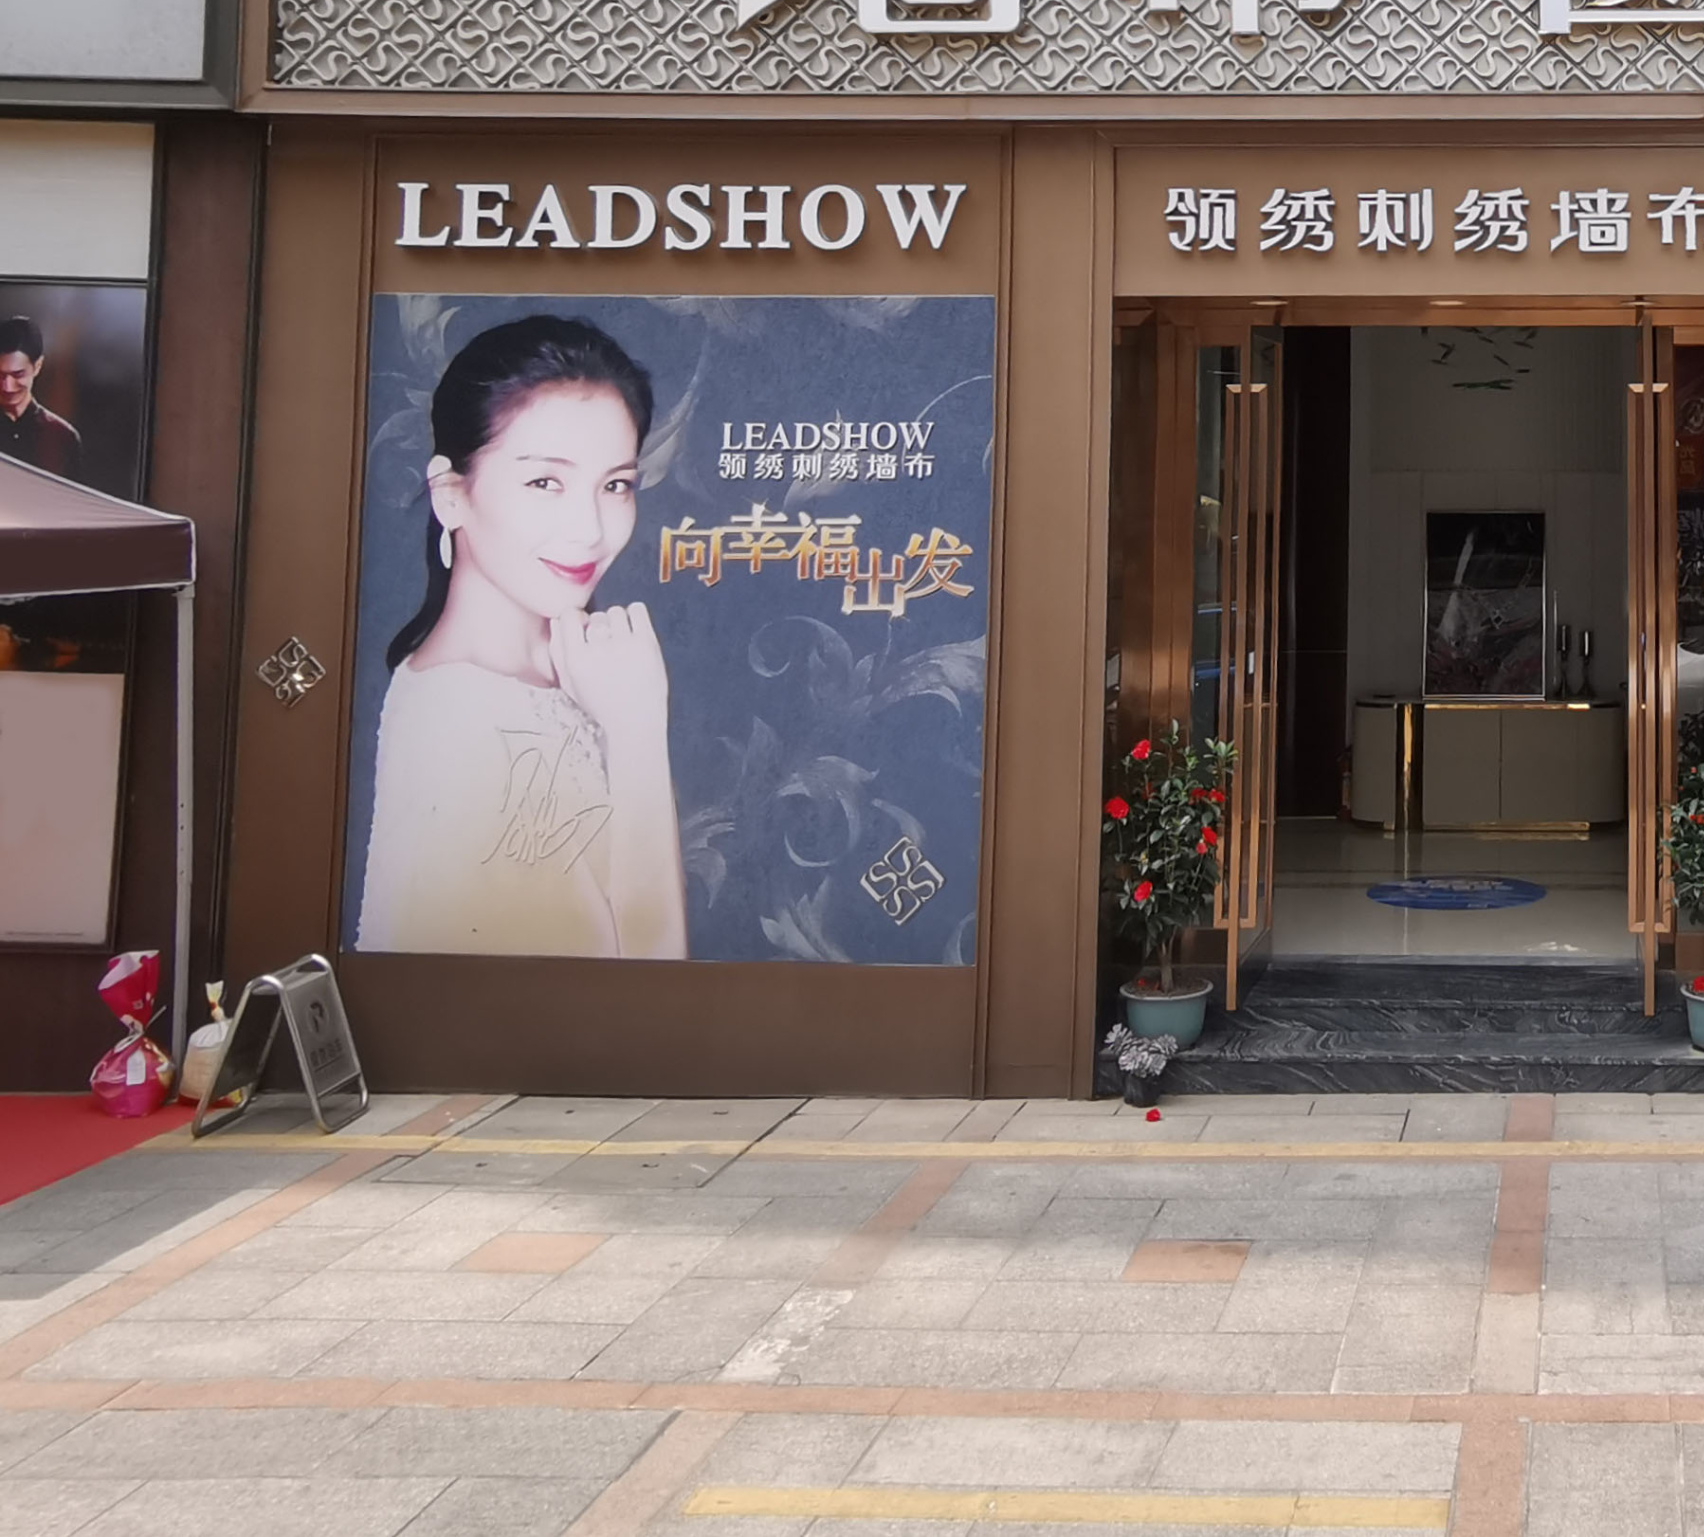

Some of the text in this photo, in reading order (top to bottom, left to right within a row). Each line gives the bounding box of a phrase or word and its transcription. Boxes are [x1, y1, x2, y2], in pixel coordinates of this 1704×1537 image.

[394, 181, 968, 250] LEADSHOW
[721, 421, 935, 451] LEADSHOW
[717, 452, 936, 481] 领绣刺绣墙布
[659, 501, 976, 617] 向幸福出发
